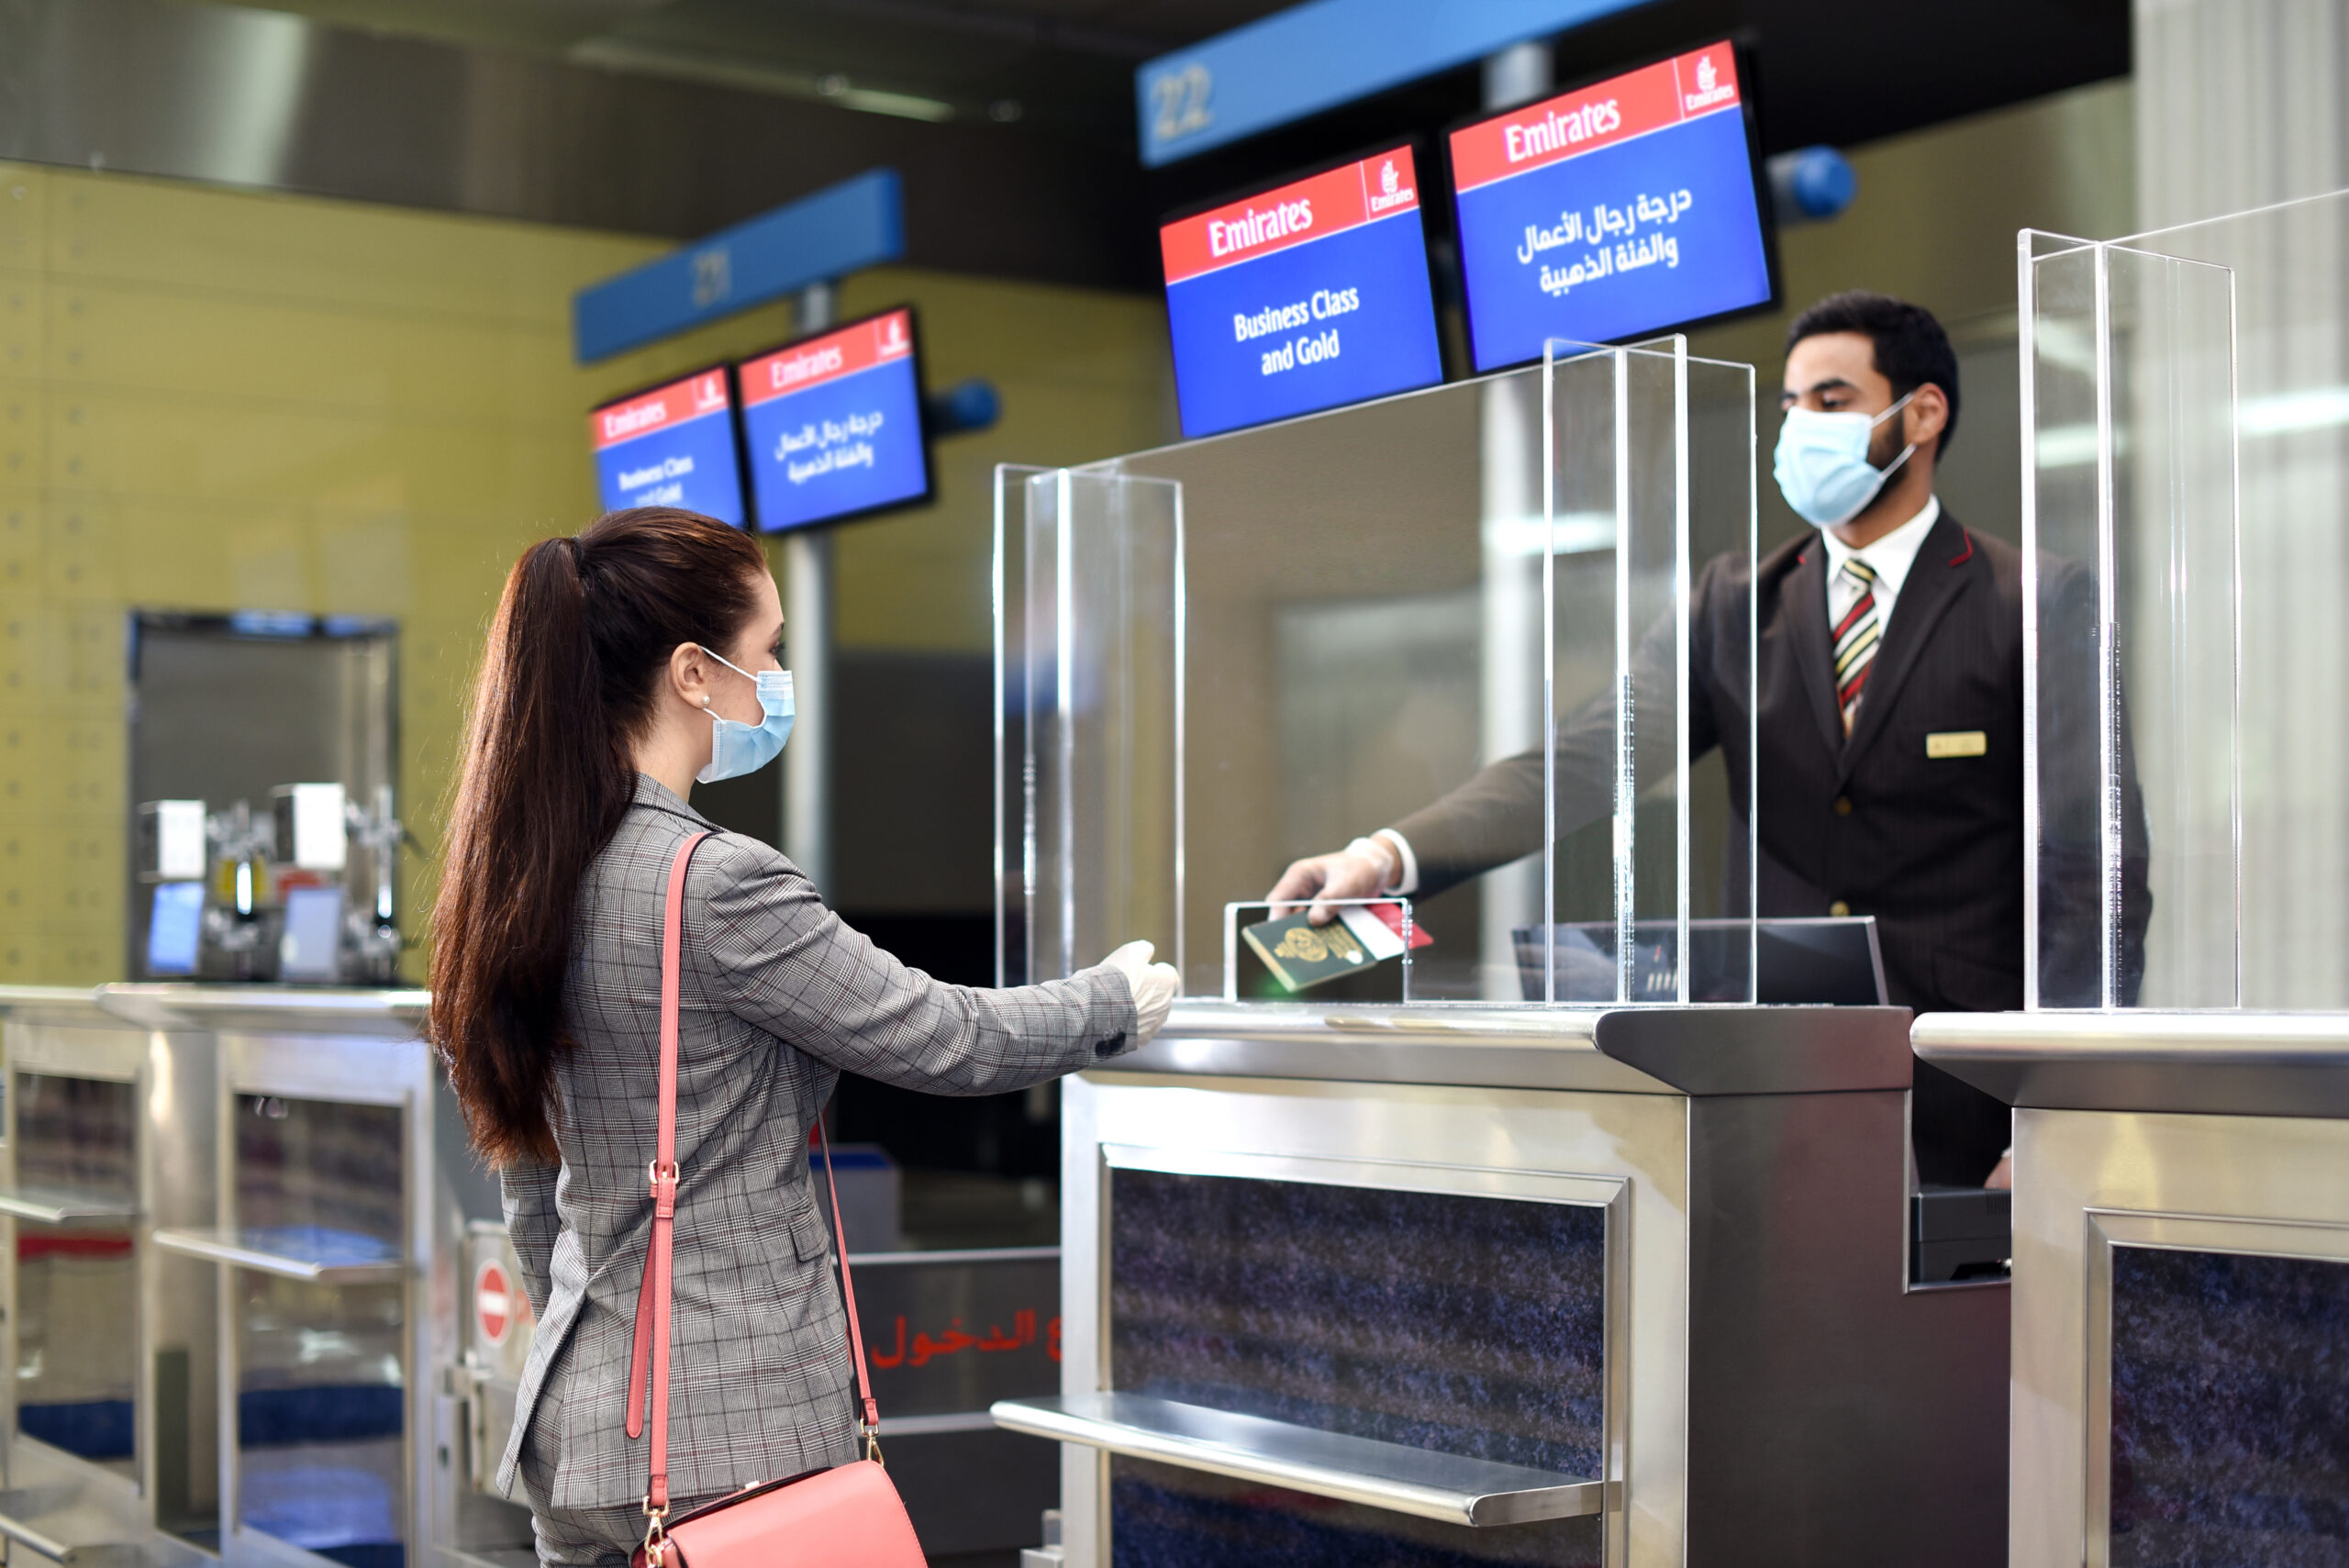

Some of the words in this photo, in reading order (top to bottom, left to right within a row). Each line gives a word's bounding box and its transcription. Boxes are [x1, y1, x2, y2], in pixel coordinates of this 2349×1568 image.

[1686, 83, 1734, 110] Emirates
[1505, 98, 1621, 162] Emirates
[1371, 188, 1415, 212] Emirates
[1637, 189, 1692, 225] درجة
[1208, 198, 1313, 258] Emirates
[1517, 211, 1584, 264] الأعمال
[1586, 204, 1635, 245] رجال
[1540, 247, 1613, 297] الذهبية
[1616, 232, 1679, 268] والفئة
[1234, 301, 1309, 342] Business
[1311, 287, 1359, 319] Class
[771, 345, 842, 389] Emirates
[1262, 339, 1294, 375] and
[1297, 328, 1340, 365] Gold
[870, 1308, 1037, 1369] الدخول
